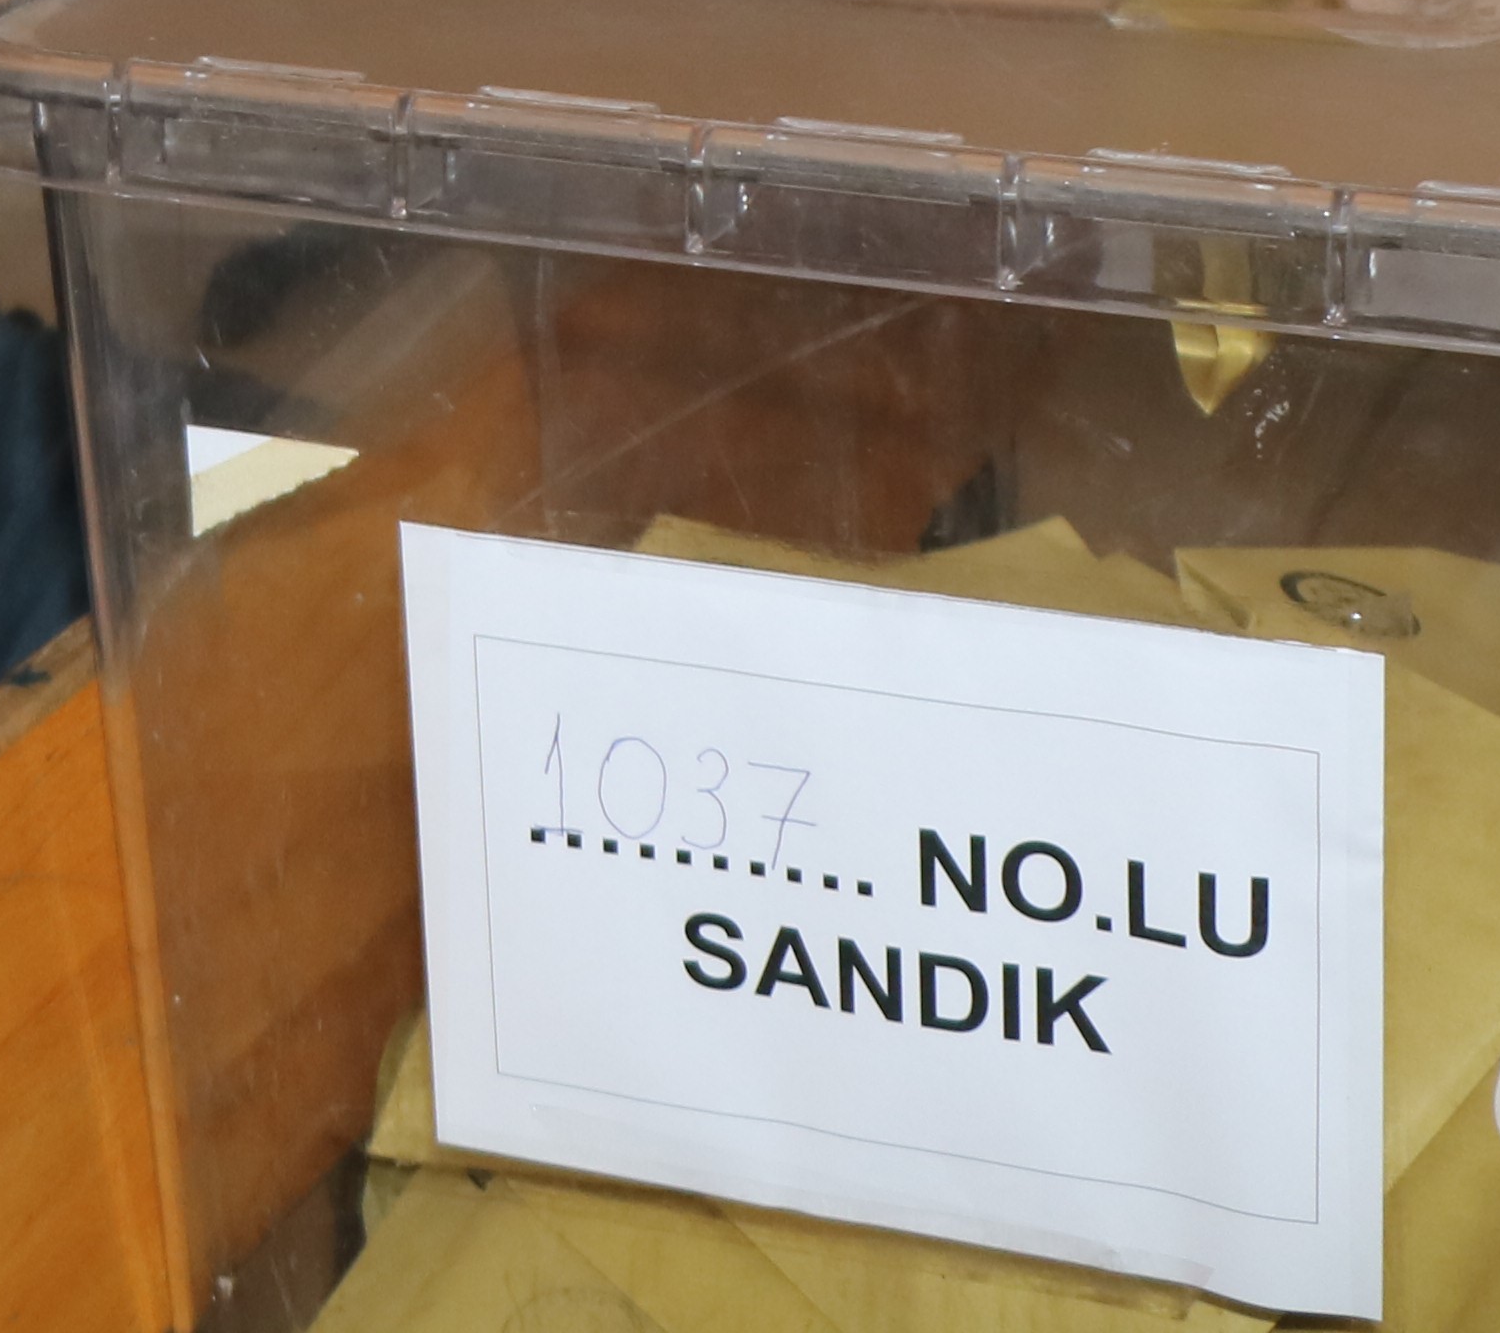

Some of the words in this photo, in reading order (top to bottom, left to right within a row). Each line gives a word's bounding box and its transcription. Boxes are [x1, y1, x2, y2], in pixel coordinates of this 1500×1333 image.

[533, 712, 817, 870] 1037
[918, 828, 1270, 959] NO.LU
[682, 913, 1111, 1054] SANDIK
